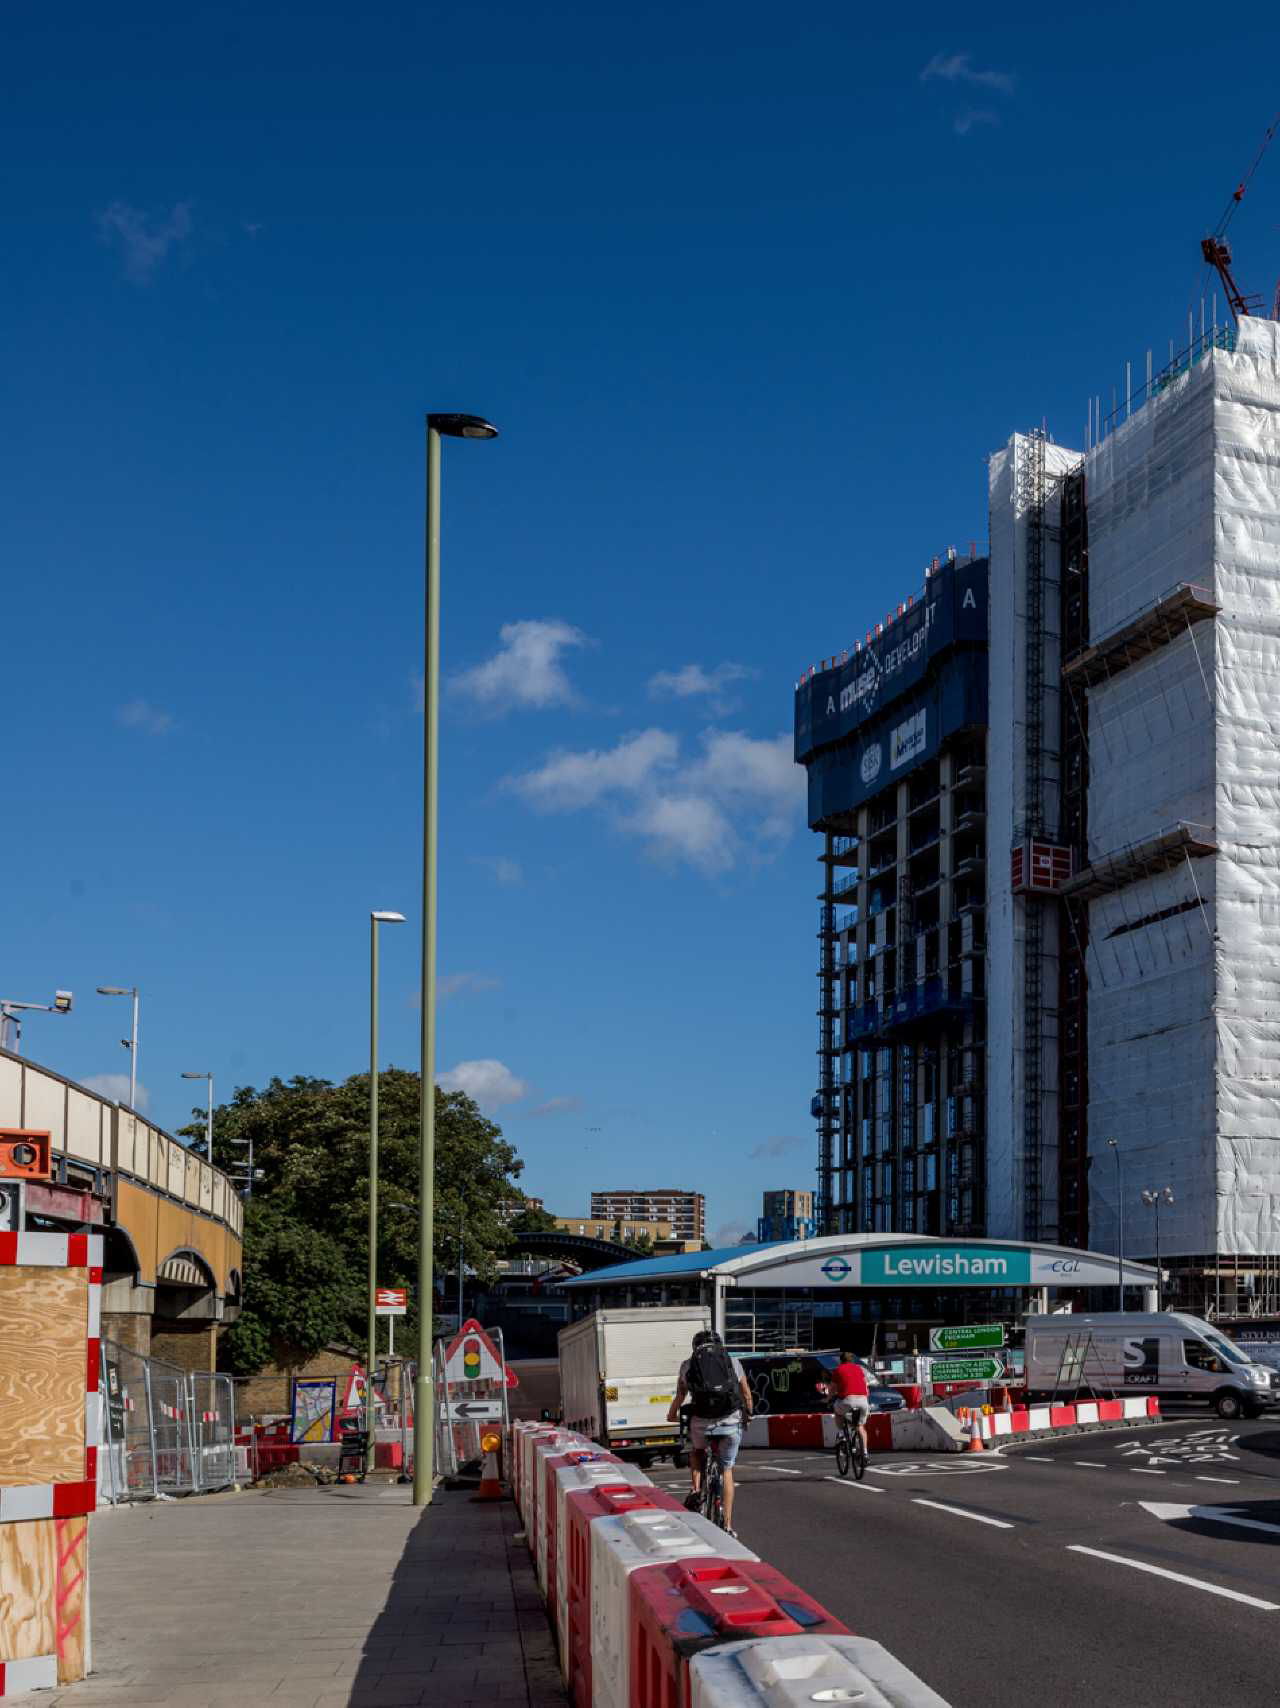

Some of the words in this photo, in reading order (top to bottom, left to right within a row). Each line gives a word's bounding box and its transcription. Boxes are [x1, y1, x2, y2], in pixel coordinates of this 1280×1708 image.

[963, 587, 977, 609] A
[826, 695, 837, 715] A
[884, 1254, 1008, 1277] Lewisham
[1052, 1260, 1081, 1273] CGL
